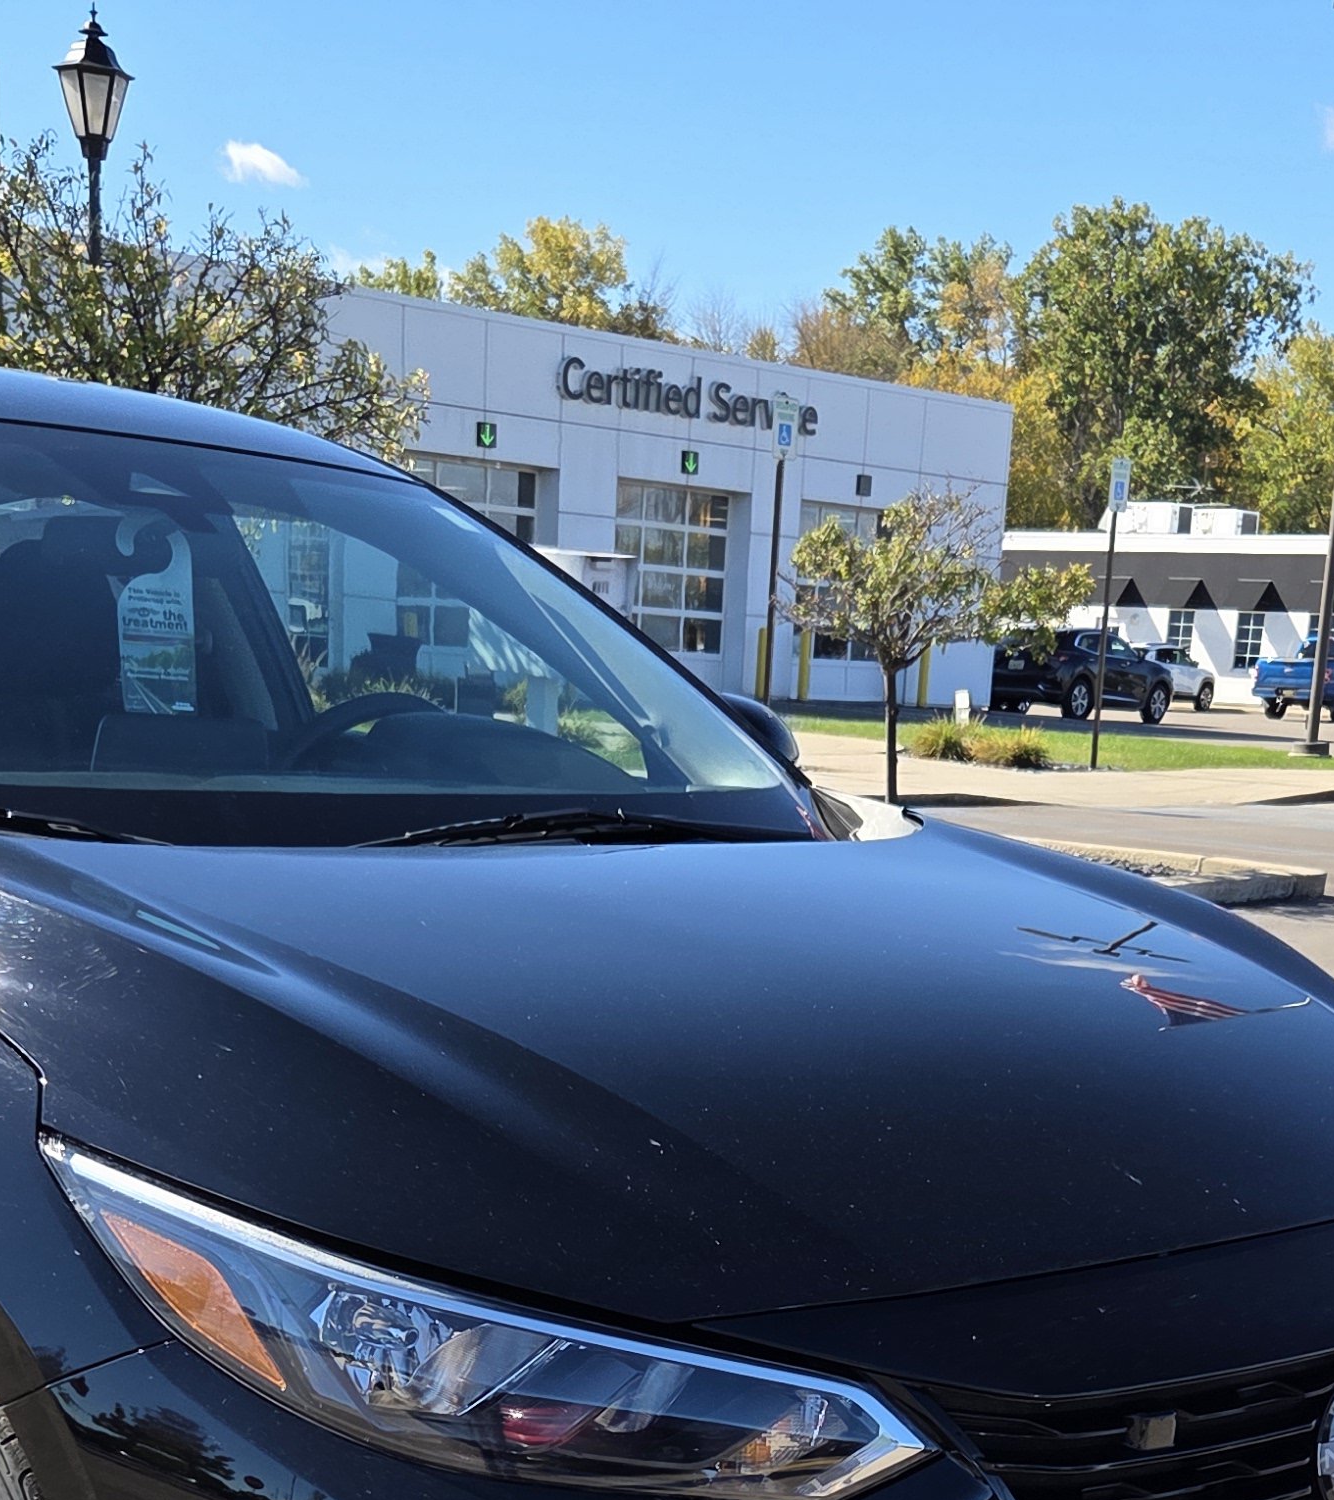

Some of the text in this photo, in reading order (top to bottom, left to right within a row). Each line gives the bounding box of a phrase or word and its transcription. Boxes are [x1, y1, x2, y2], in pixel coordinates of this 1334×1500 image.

[558, 356, 818, 436] Certified Serve
[163, 609, 185, 622] the
[122, 616, 188, 631] treatment
